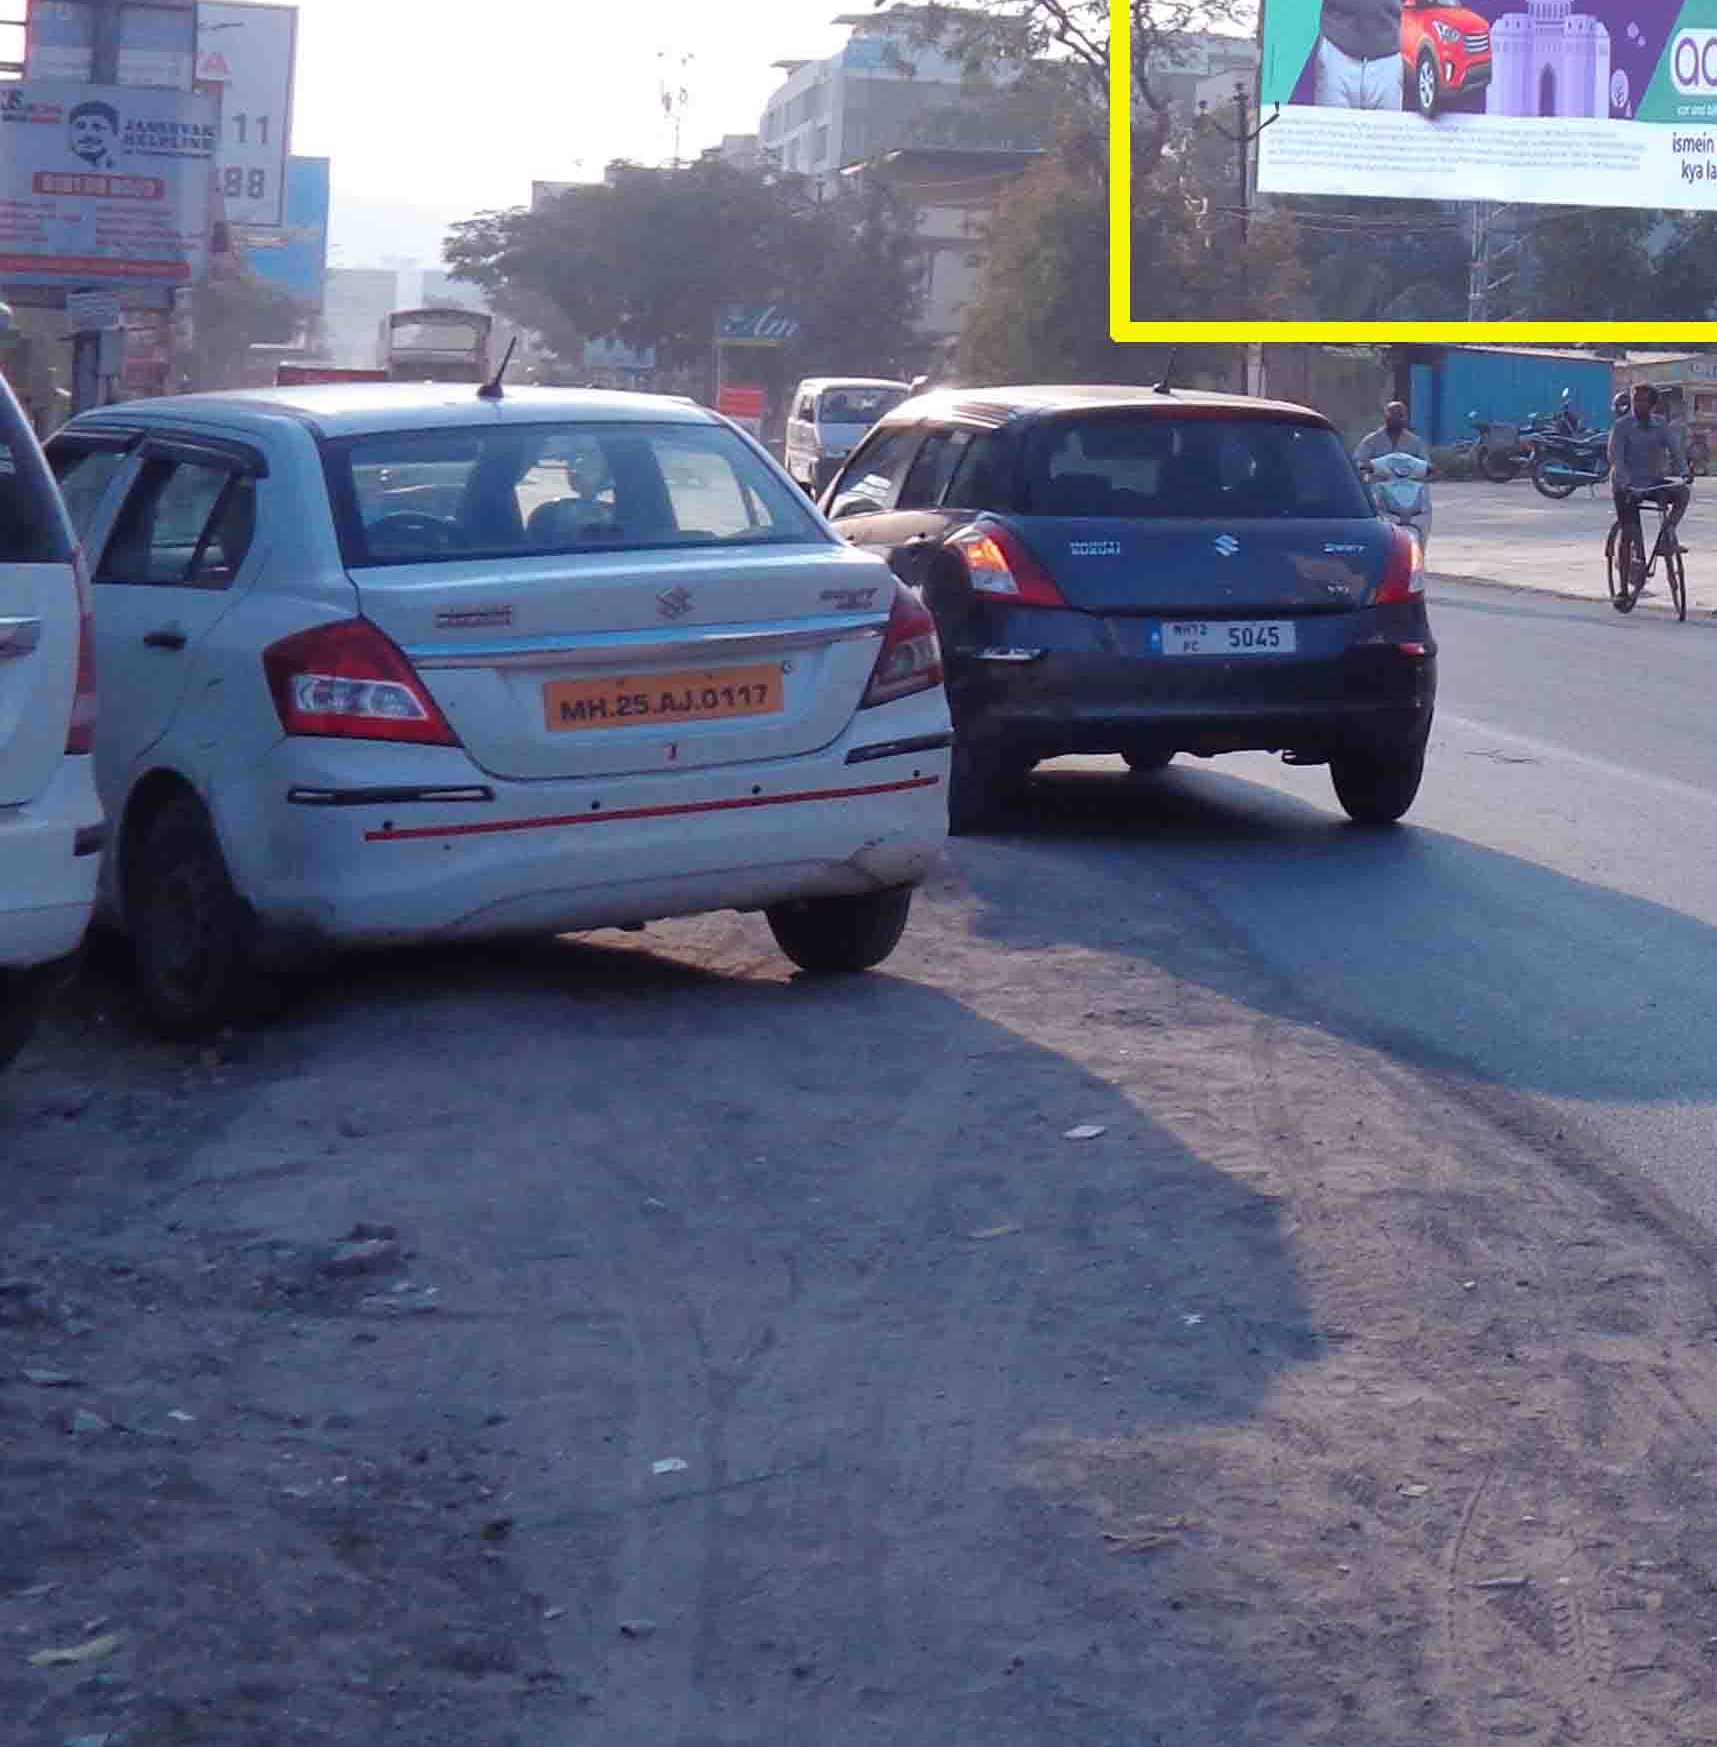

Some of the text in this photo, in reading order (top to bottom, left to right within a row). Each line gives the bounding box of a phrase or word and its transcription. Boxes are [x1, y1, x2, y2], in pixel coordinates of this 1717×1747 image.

[1672, 131, 1715, 154] ismein
[1681, 159, 1704, 184] kya
[1228, 626, 1281, 648] 5045
